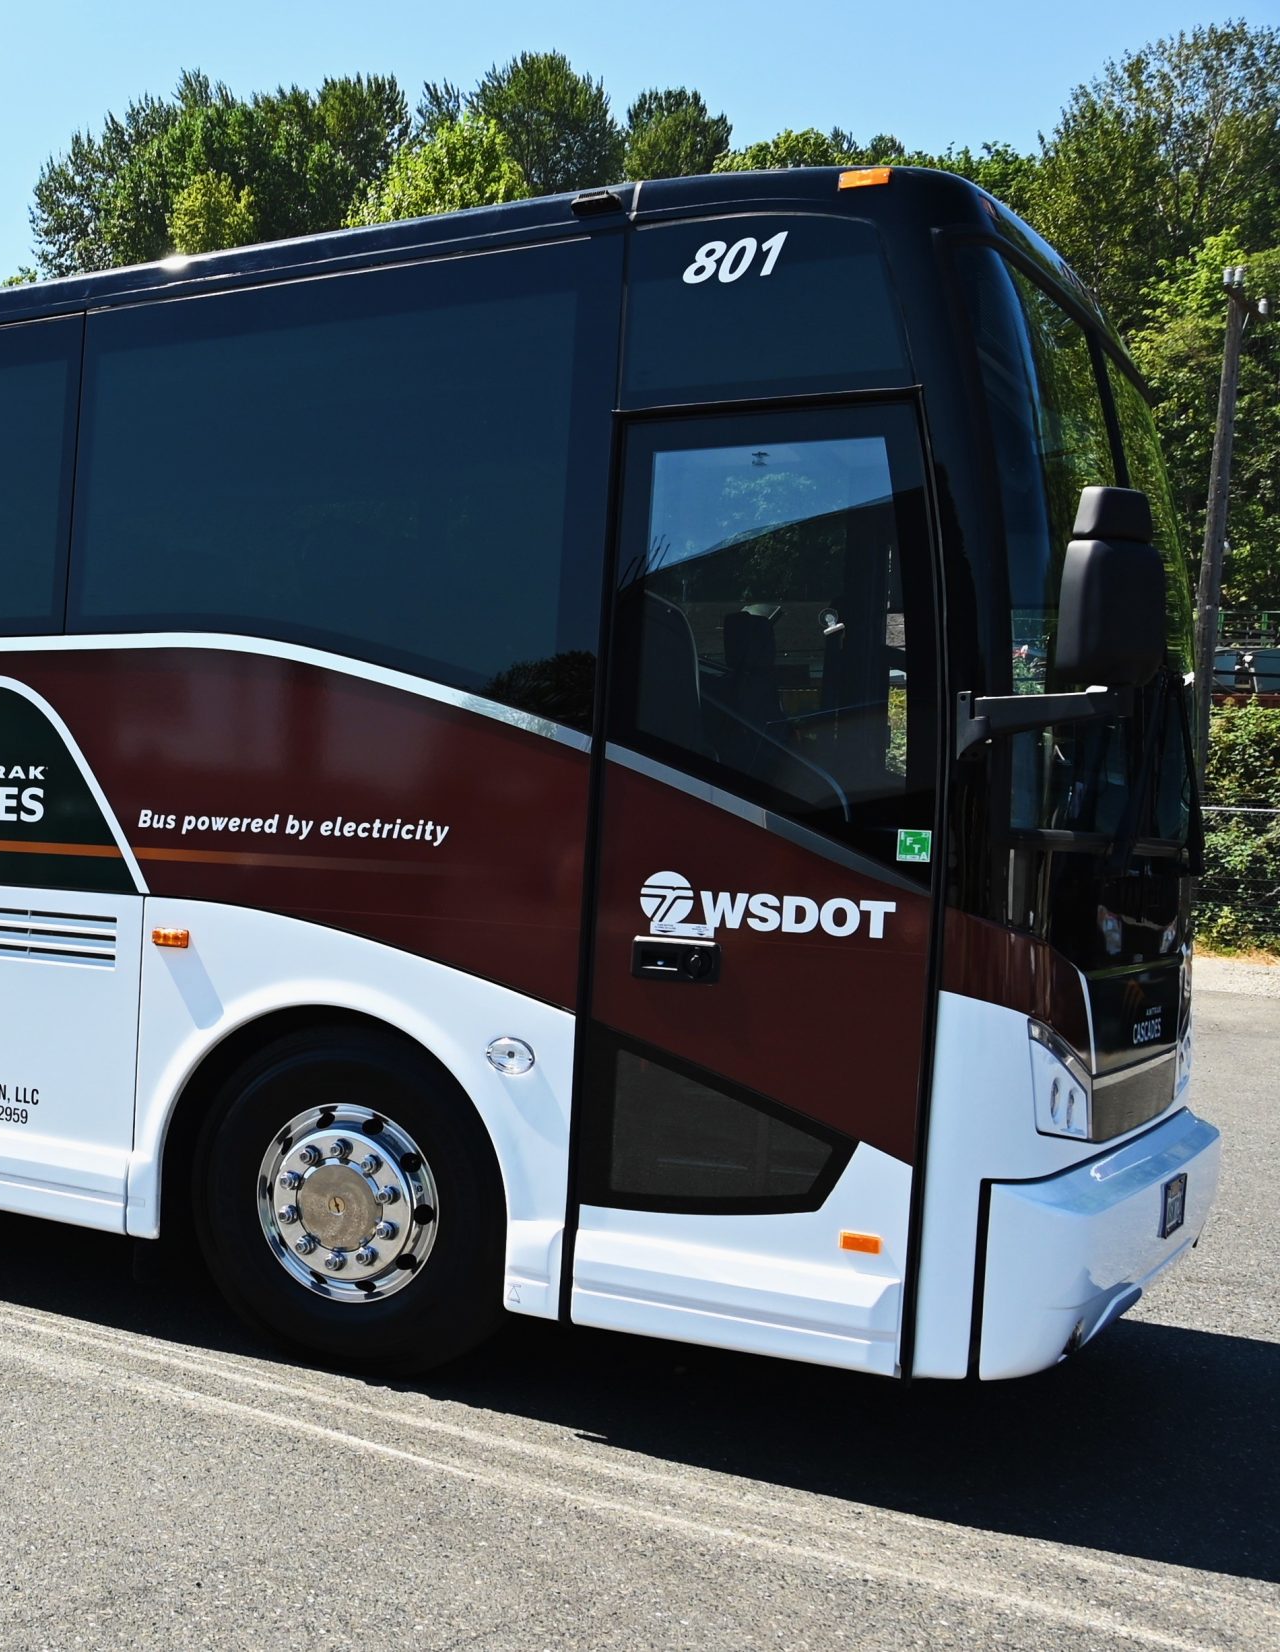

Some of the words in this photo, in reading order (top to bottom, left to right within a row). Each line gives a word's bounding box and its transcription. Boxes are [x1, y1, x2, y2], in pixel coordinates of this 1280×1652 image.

[682, 230, 789, 284] 801
[137, 809, 176, 829] Bus
[181, 814, 280, 835] powered
[285, 815, 314, 840] by
[319, 816, 450, 847] electricity
[699, 890, 897, 939] WSDOT
[15, 1086, 40, 1106] LLC
